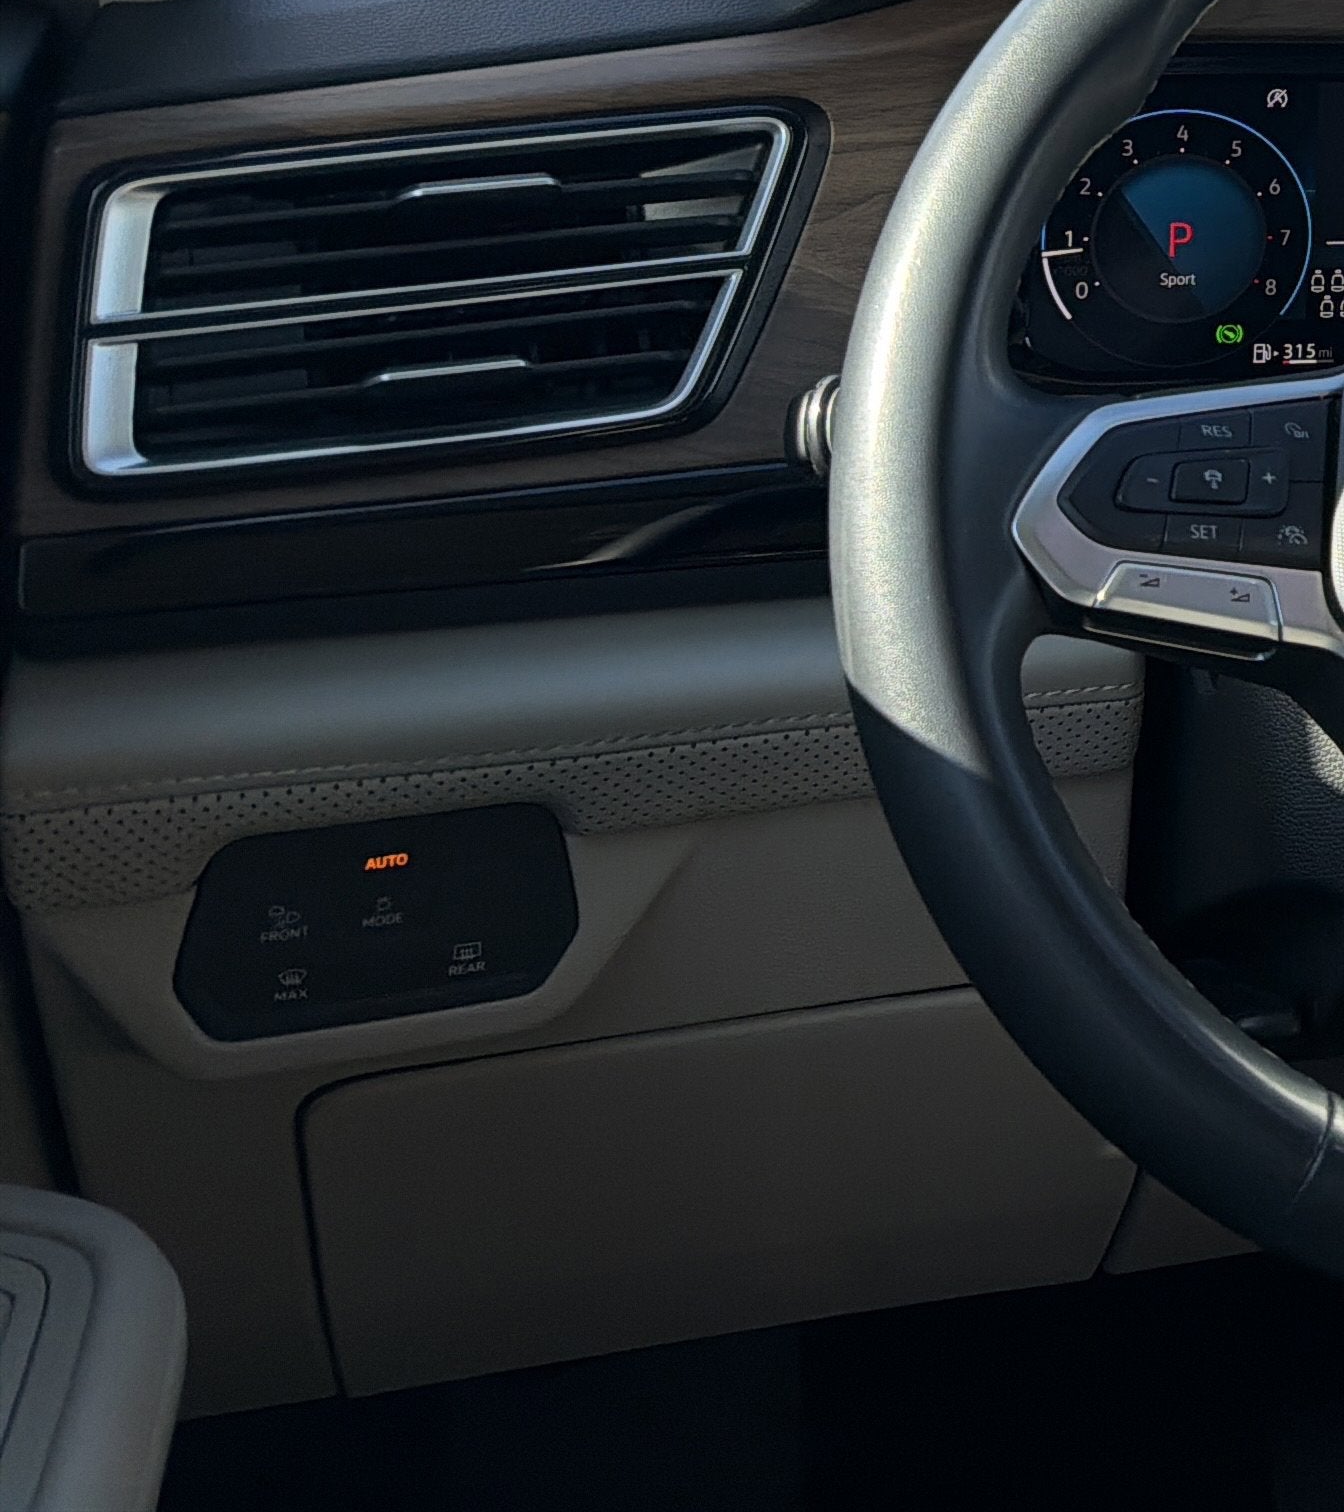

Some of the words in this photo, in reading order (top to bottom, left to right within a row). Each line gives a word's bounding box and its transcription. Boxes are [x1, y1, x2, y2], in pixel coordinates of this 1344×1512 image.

[1177, 125, 1188, 142] 4
[1122, 139, 1134, 156] 3
[1231, 140, 1242, 157] 5
[1079, 178, 1091, 195] 2
[1269, 178, 1280, 195] 6
[1064, 230, 1073, 247] 1
[1168, 222, 1194, 259] P
[1280, 229, 1291, 246] 7
[1160, 272, 1197, 288] Sport
[1265, 279, 1277, 295] 8
[1075, 282, 1088, 299] 0
[1282, 343, 1316, 359] 315
[1318, 346, 1333, 358] mi
[1201, 424, 1233, 438] RES
[1190, 524, 1217, 539] SET
[364, 852, 409, 871] AUTO
[362, 912, 404, 928] MODE
[260, 925, 309, 944] FRONT
[448, 960, 487, 978] REAR
[273, 988, 309, 1002] MAX
